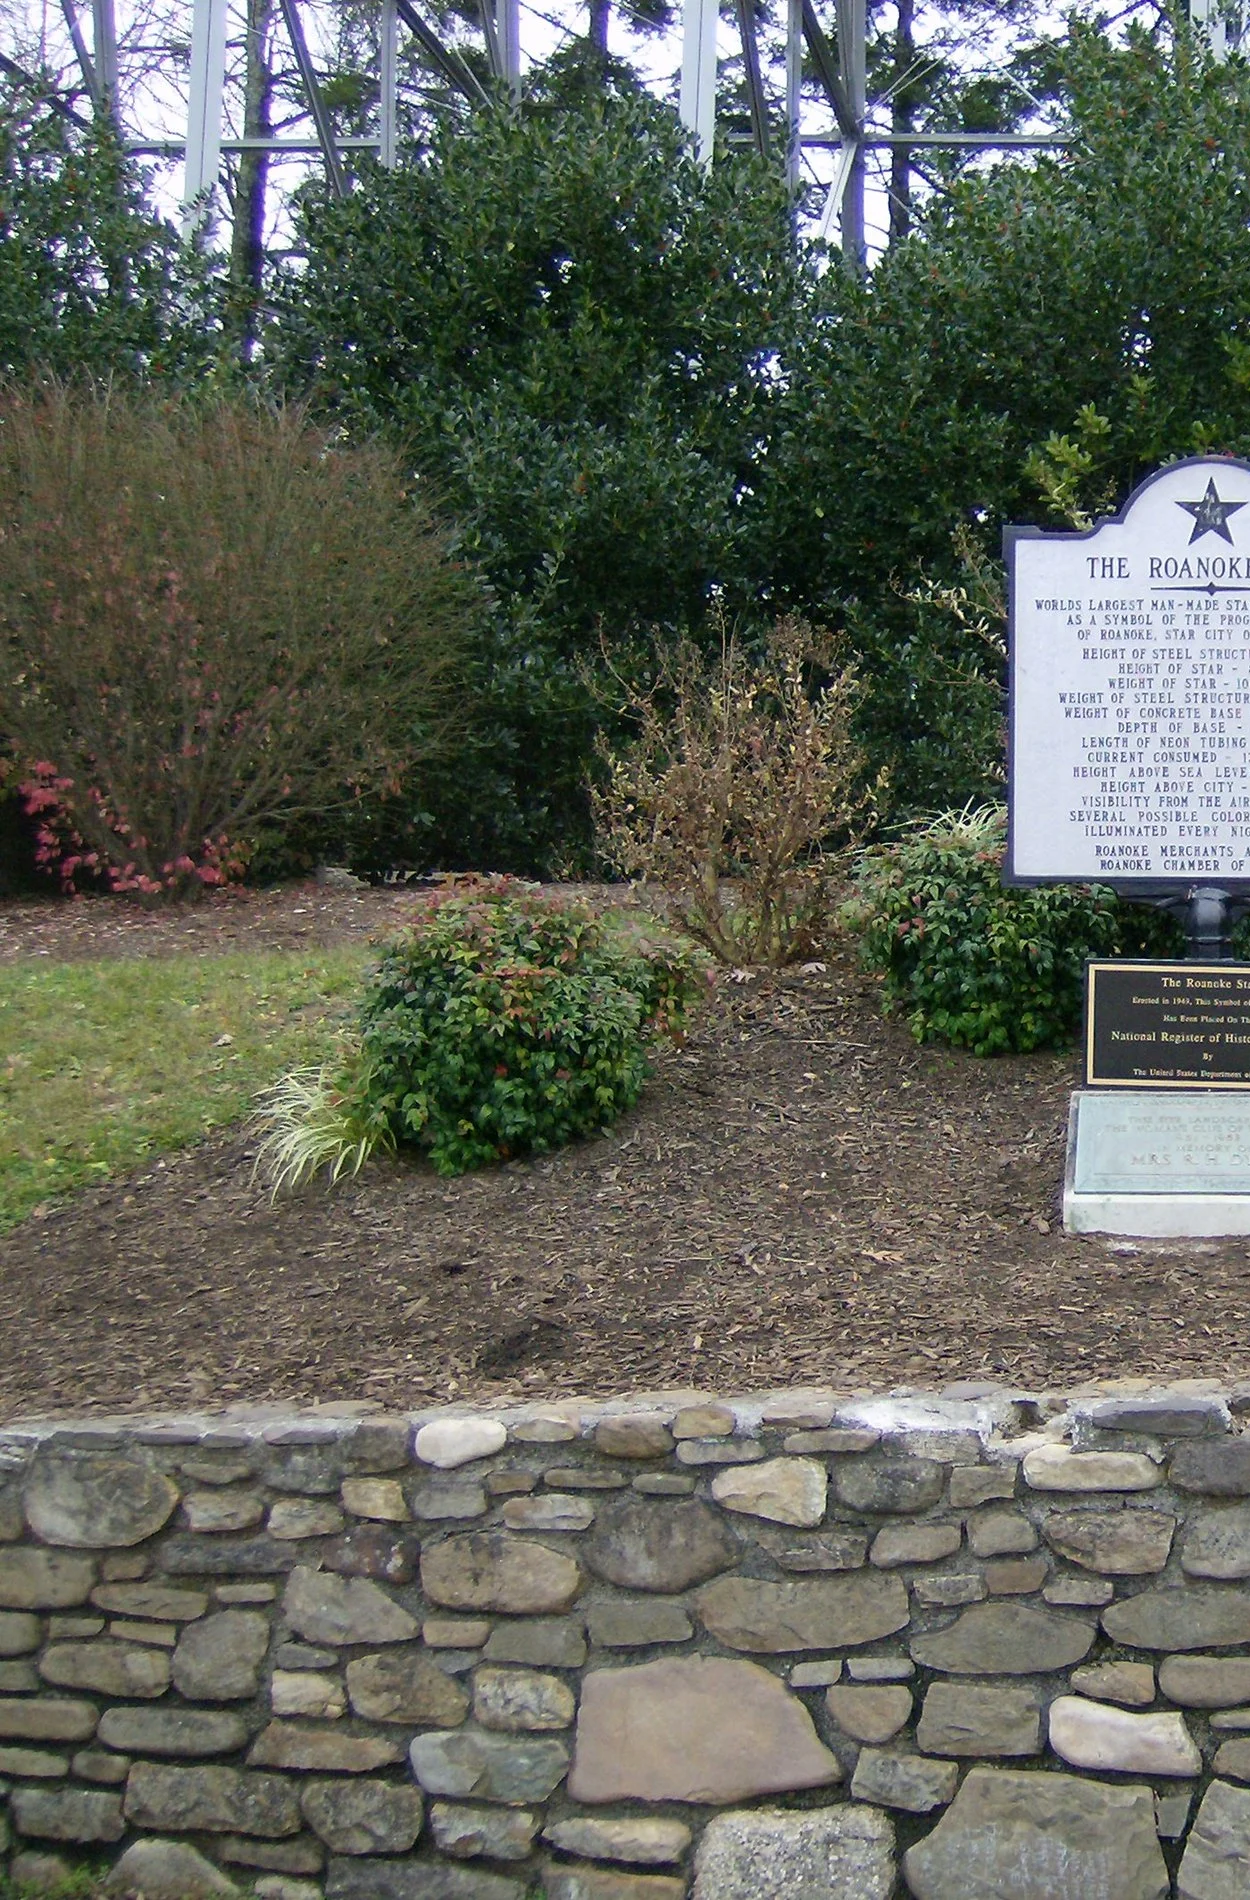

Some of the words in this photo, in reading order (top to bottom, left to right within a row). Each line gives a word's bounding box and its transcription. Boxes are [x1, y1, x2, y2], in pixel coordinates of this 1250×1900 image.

[1086, 557, 1130, 579] THE
[1035, 599, 1082, 612] WORLDS
[1088, 599, 1145, 612] LARGEST
[1151, 599, 1220, 612] MAN-MADE
[1067, 614, 1082, 626] AS
[1090, 615, 1096, 627] A
[1105, 614, 1152, 626] SYMBOL
[1162, 614, 1177, 626] OF
[1185, 614, 1209, 626] THE
[1078, 628, 1091, 640] OF
[1164, 628, 1196, 641] STAR
[1204, 628, 1234, 641] CITY
[1083, 648, 1126, 660] HEIGHT
[1131, 647, 1147, 660] OF
[1152, 648, 1192, 660] STEEL
[1118, 663, 1160, 675] HEIGHT
[1168, 663, 1182, 675] OF
[1192, 663, 1224, 675] STAR
[1107, 677, 1155, 690] WEIGHT
[1161, 677, 1177, 690] OF
[1183, 677, 1217, 690] STAR
[1059, 692, 1104, 704] WEIGHT
[1111, 692, 1124, 704] OF
[1134, 692, 1174, 704] STEEL
[1065, 706, 1108, 718] WEIGHT
[1115, 707, 1131, 720] OF
[1139, 706, 1202, 719] CONCRETE
[1211, 708, 1241, 720] BASE
[1118, 722, 1158, 734] DEPTH
[1168, 722, 1183, 734] OF
[1193, 722, 1226, 735] BASE
[1082, 737, 1128, 749] LENGTH
[1136, 736, 1151, 749] OF
[1159, 736, 1190, 749] NEON
[1199, 737, 1247, 750] TUBING
[1087, 751, 1145, 764] CURRENT
[1153, 751, 1217, 764] CONSUMED
[1073, 766, 1116, 778] HEIGHT
[1129, 766, 1169, 778] ABOVE
[1179, 765, 1203, 778] SEA
[1101, 781, 1145, 793] HEIGHT
[1154, 781, 1194, 793] ABOVE
[1203, 780, 1234, 793] CITY
[1082, 796, 1150, 808] VISIBILITY
[1158, 795, 1189, 808] FROM
[1197, 795, 1222, 808] THE
[1229, 796, 1250, 809] AIR
[1070, 811, 1125, 823] SEVERAL
[1137, 810, 1199, 823] POSSIBLE
[1211, 811, 1250, 824] COLOR
[1085, 825, 1167, 839] ILLUMINATED
[1178, 824, 1219, 837] EVERY
[1095, 845, 1149, 857] ROANOKE
[1160, 845, 1233, 857] MERCHANTS
[1099, 858, 1152, 871] ROANOKE
[1163, 858, 1220, 871] CHAMBER
[1231, 860, 1244, 872] OF
[1160, 976, 1182, 988] The
[1185, 977, 1232, 989] Roanoke
[1110, 1031, 1156, 1042] National
[1161, 1032, 1205, 1045] Register
[1208, 1031, 1222, 1043] of
[1202, 1052, 1214, 1062] By
